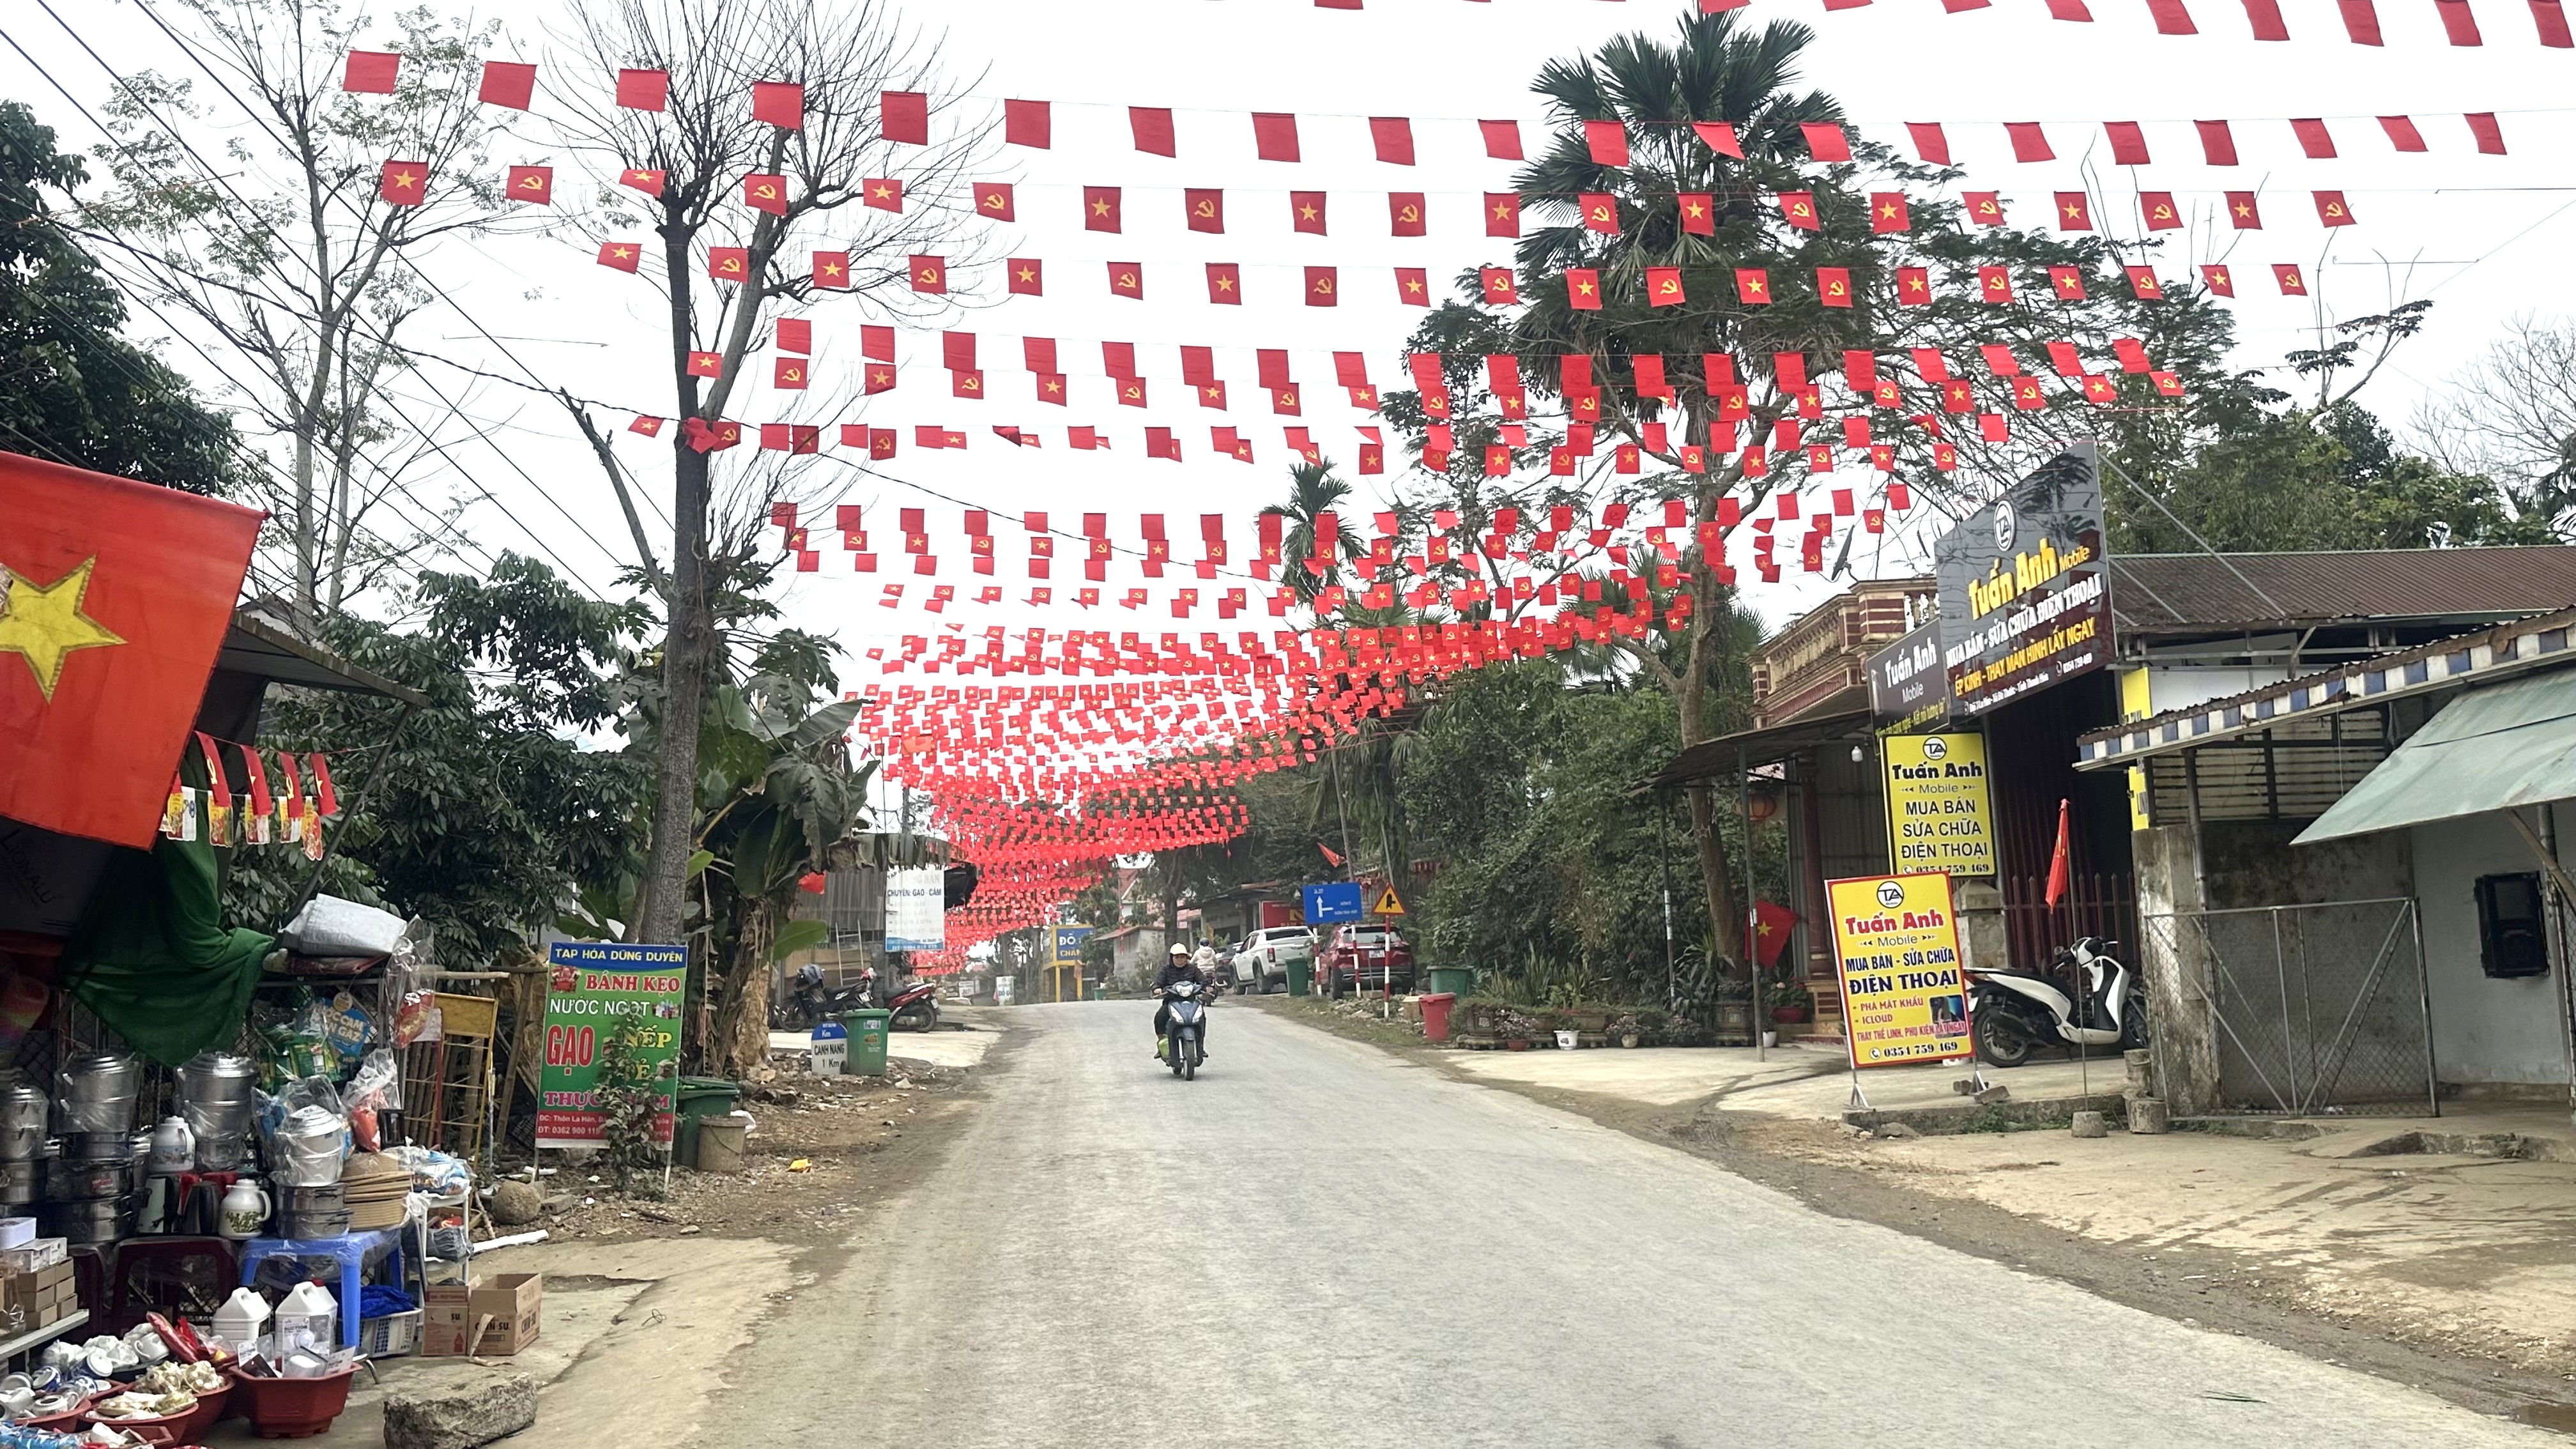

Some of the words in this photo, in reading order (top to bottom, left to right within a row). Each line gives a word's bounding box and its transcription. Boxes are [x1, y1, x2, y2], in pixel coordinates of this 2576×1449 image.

[1968, 557, 2014, 620] Tuấn
[2016, 537, 2058, 596] Anh
[2058, 546, 2090, 572] Mobile
[1946, 642, 1966, 669] MUA
[1965, 631, 1986, 660] BÁN
[1988, 618, 2009, 648] SỬA
[2008, 604, 2037, 638] CHỮA
[2036, 590, 2064, 624] ĐIỆN
[2063, 573, 2104, 610] THOẠI
[1885, 648, 1912, 688] Tuấn
[1913, 637, 1936, 674] Anh
[1963, 668, 1982, 693] KÍNH
[1986, 659, 2006, 682] THAY
[2006, 647, 2027, 673] MÀN
[2026, 638, 2048, 666] HÌNH
[2048, 625, 2067, 655] LẤY
[2066, 617, 2096, 647] NGAY
[1902, 682, 1924, 703] Mobile
[1892, 761, 1939, 779] Tuấn
[1944, 762, 1982, 778] Anh
[1919, 784, 1958, 794] Mobile
[1906, 801, 1939, 815] MUA
[1944, 796, 1975, 814] BÁN
[1903, 818, 1935, 837] SỬA
[1938, 817, 1982, 836] CHỮA
[1901, 841, 1936, 862] ĐIỆN
[1941, 842, 1988, 860] THOẠI
[1845, 912, 1897, 935] Tuấn
[1903, 909, 1943, 930] Anh
[1877, 935, 1917, 947] Mobile
[555, 949, 578, 960] TẠP
[582, 948, 606, 959] HÓA
[611, 949, 641, 961] DŨNG
[646, 951, 683, 962] DUYÊN
[1845, 957, 1869, 972] MUA
[1872, 952, 1893, 969] BÁN
[1903, 947, 1924, 966] SỬA
[1926, 946, 1955, 963] CHỮA
[585, 970, 638, 992] BÁNH
[643, 975, 680, 997] KẸO
[1849, 974, 1893, 997] ĐIỆN
[1897, 969, 1958, 989] THOẠI
[549, 995, 599, 1014] NƯỚC
[1860, 1000, 1877, 1011] PHÁ
[1857, 1031, 1872, 1042] THAY
[1874, 1028, 1885, 1040] THẾ
[1905, 1027, 1918, 1038] PHỤ
[1919, 1024, 1934, 1036] KIỆN
[1947, 1021, 1966, 1033] NGAY
[546, 1024, 595, 1076] GẠO
[1914, 1044, 1934, 1054] 759
[1938, 1041, 1958, 1052] 469
[829, 1058, 839, 1068] Km
